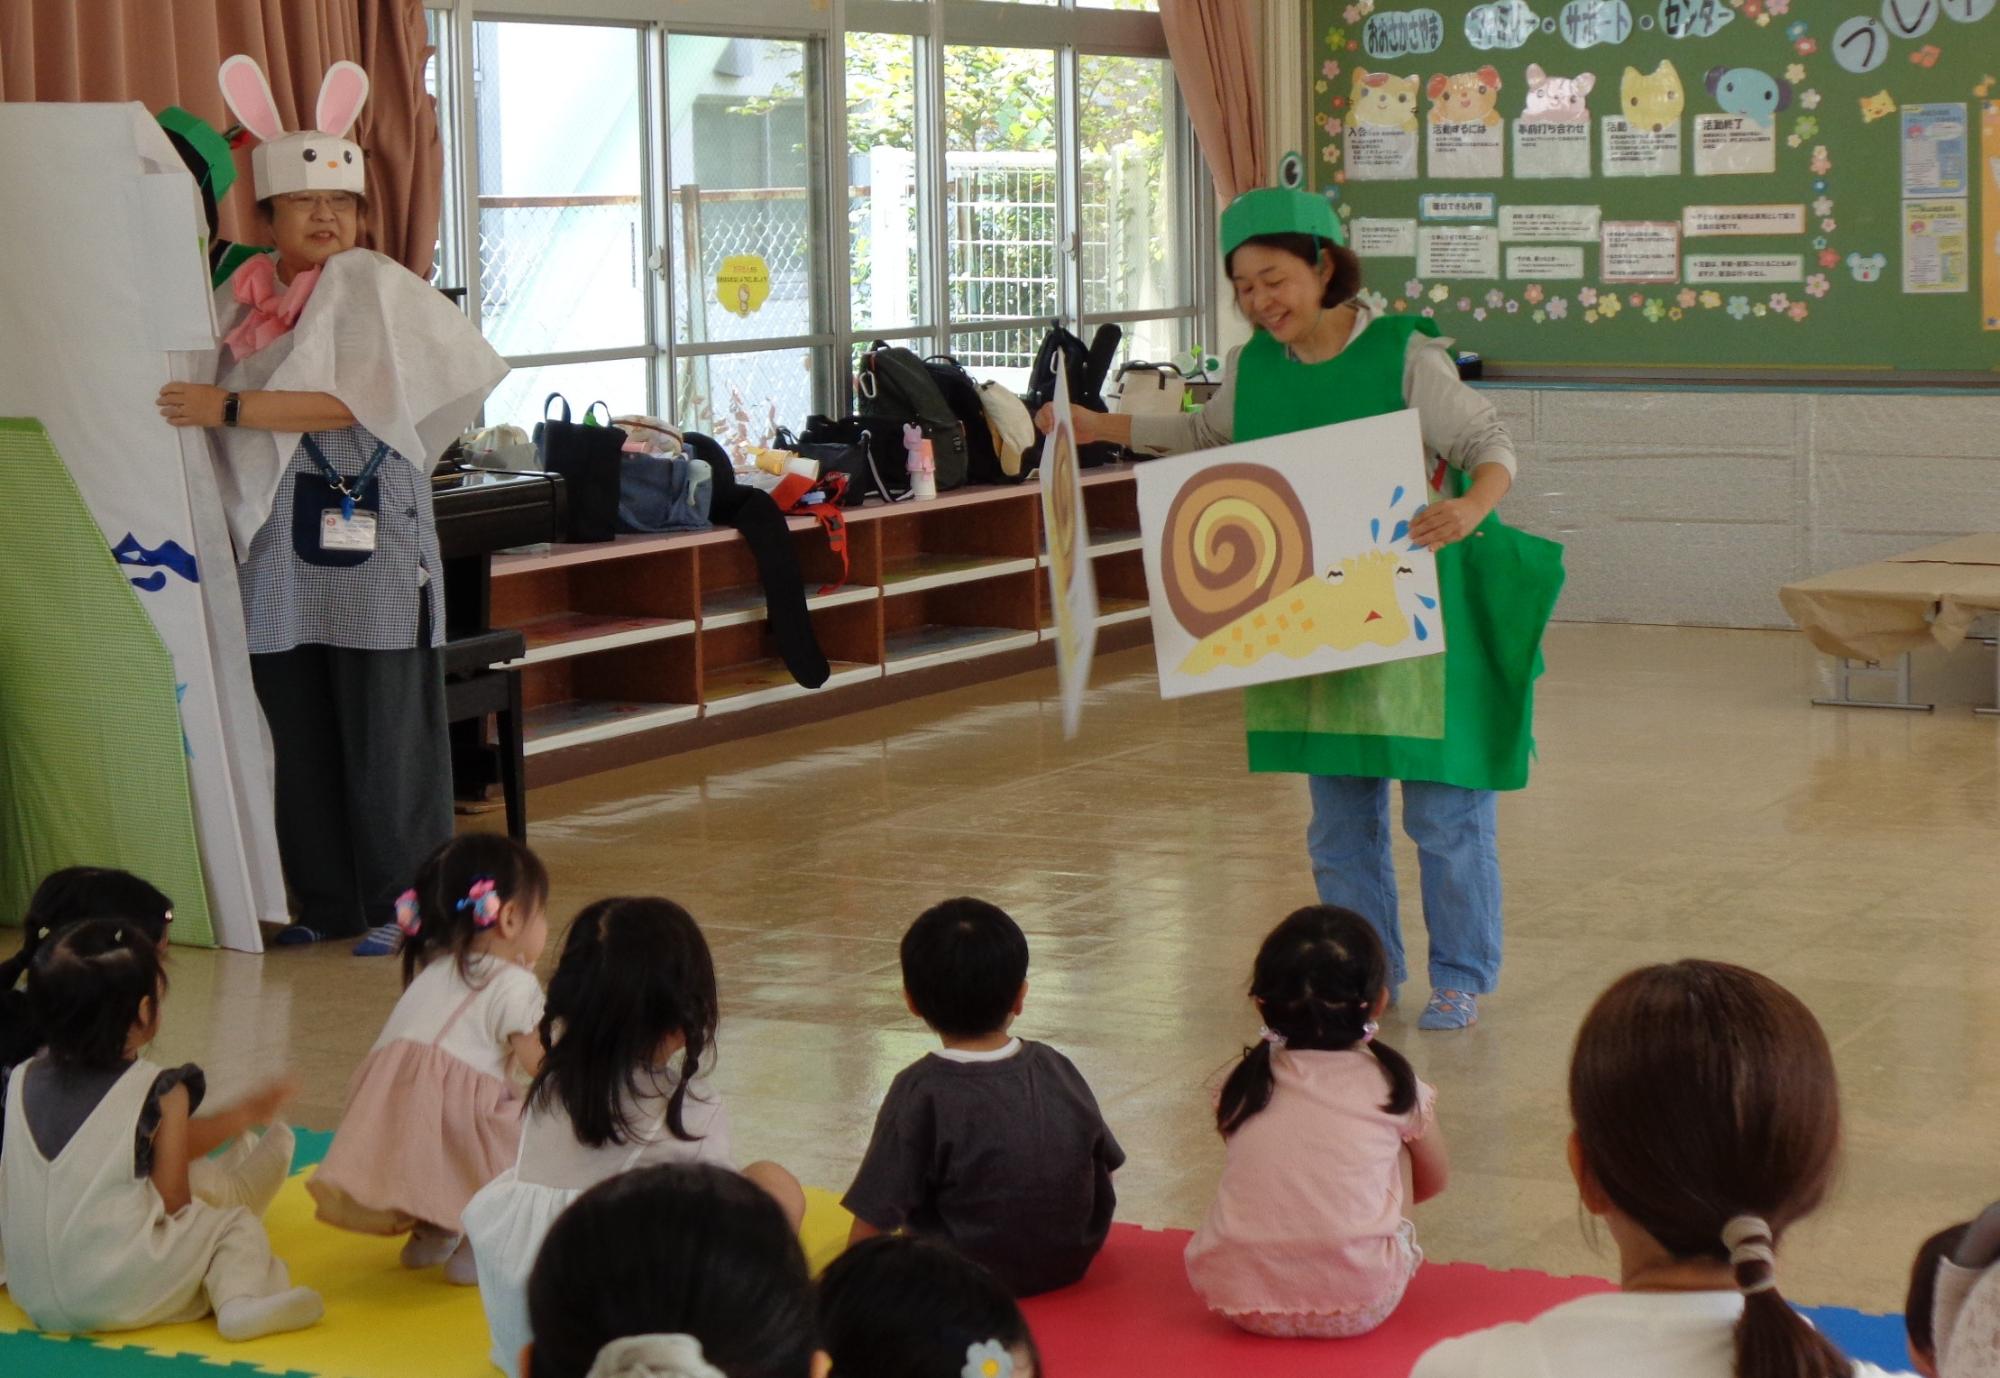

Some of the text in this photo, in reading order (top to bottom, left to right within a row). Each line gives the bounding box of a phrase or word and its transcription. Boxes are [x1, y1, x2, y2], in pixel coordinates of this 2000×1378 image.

[1367, 12, 1438, 54] おおさかさやま
[1518, 123, 1585, 135] 事前打ち合わせ
[1702, 118, 1744, 131] 活動終了
